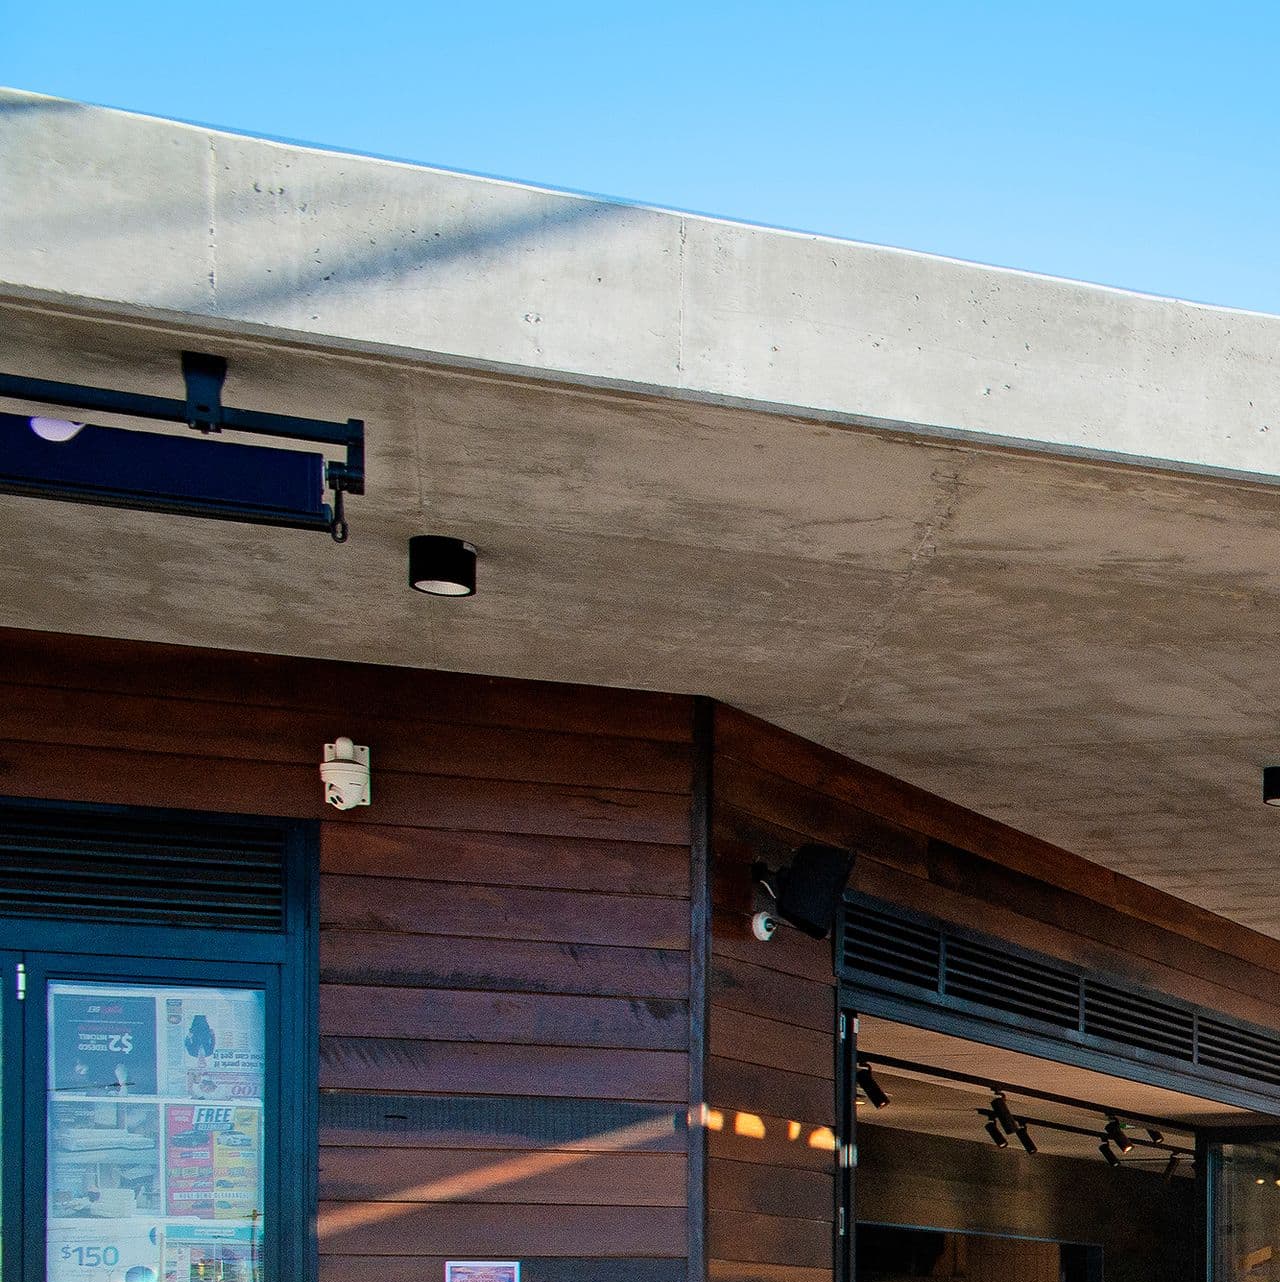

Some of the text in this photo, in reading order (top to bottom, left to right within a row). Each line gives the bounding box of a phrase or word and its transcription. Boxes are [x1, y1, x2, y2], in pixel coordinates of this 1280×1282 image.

[108, 1032, 134, 1054] $2
[196, 1108, 232, 1122] FREE
[61, 1244, 119, 1267] $150
